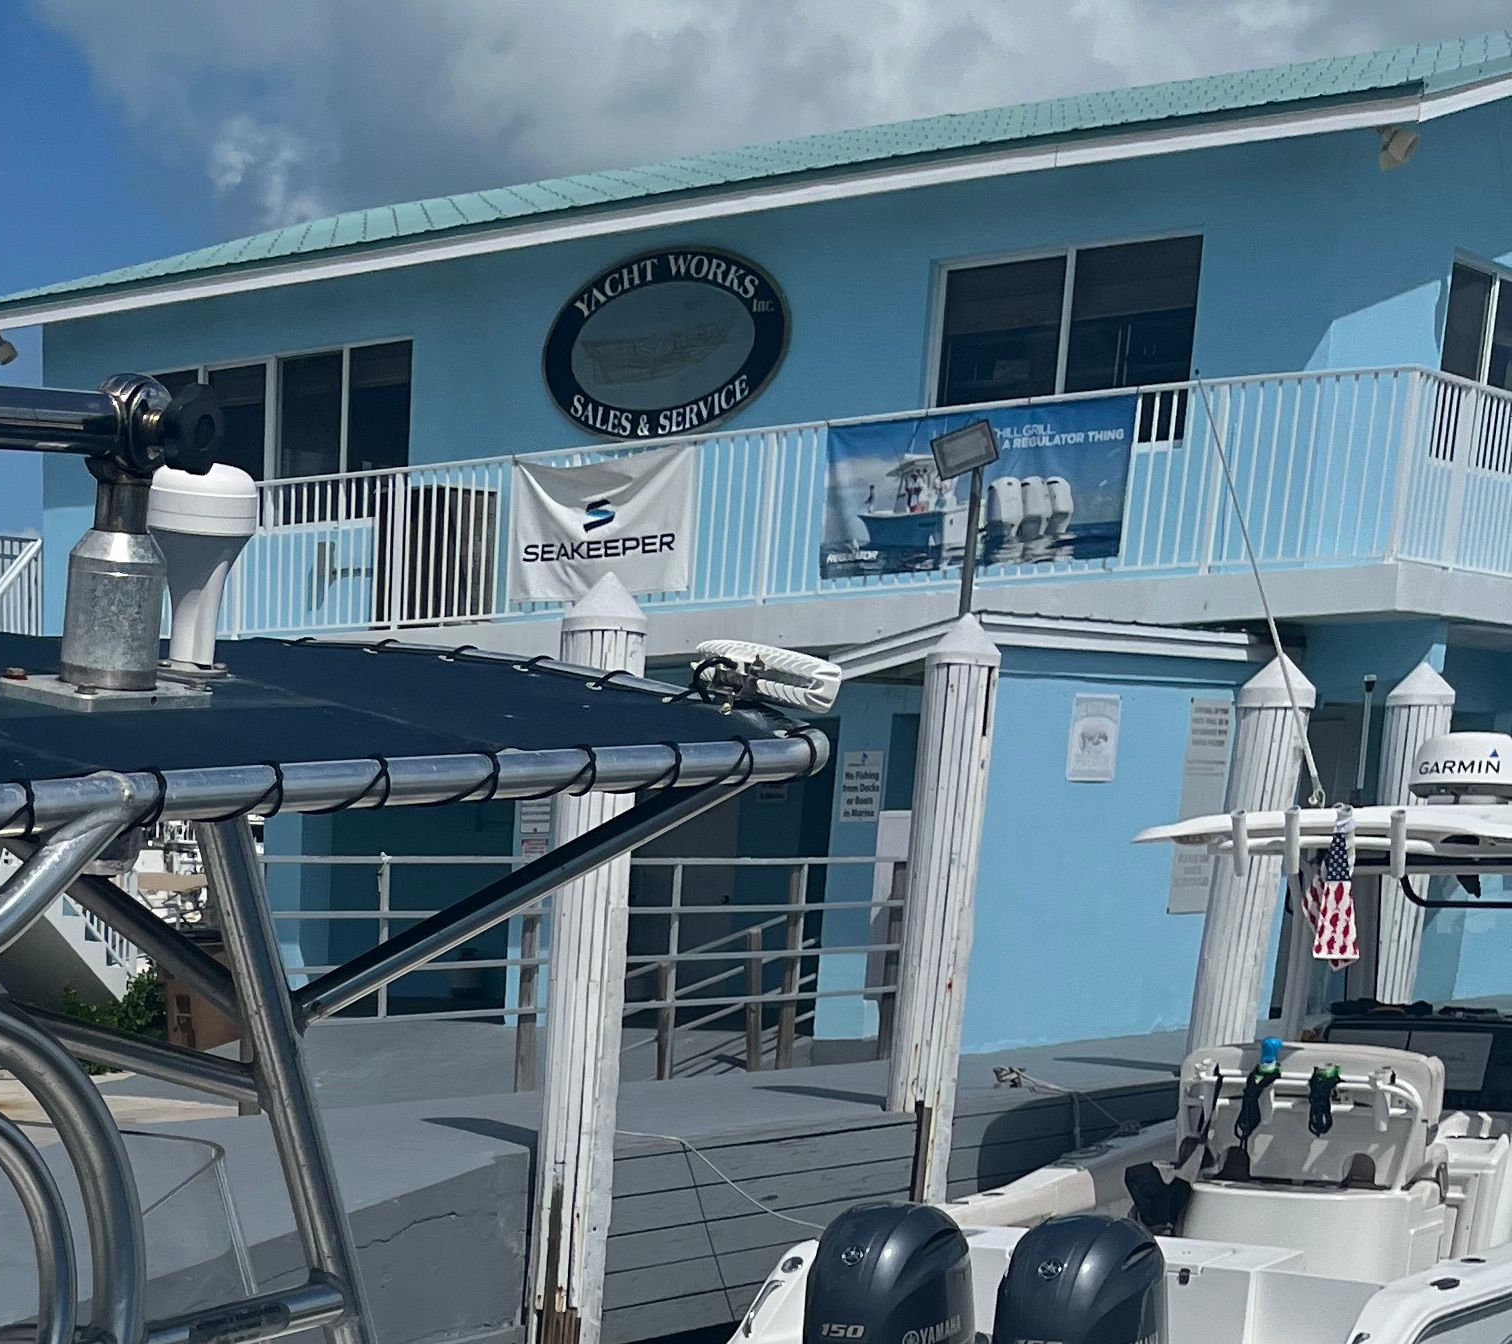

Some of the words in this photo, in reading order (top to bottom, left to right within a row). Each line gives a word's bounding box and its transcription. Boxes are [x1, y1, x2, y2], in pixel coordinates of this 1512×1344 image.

[573, 257, 659, 318] YACHT
[668, 254, 759, 299] WORKS
[570, 394, 632, 436] SALES
[637, 414, 650, 436] &
[657, 374, 750, 434] SERVICE
[1002, 440, 1011, 450] A
[1012, 432, 1084, 449] REGULATOR
[1088, 428, 1125, 442] THING
[522, 533, 675, 563] SEAKEEPER
[1419, 760, 1500, 775] GARMIN
[820, 1323, 864, 1339] 150
